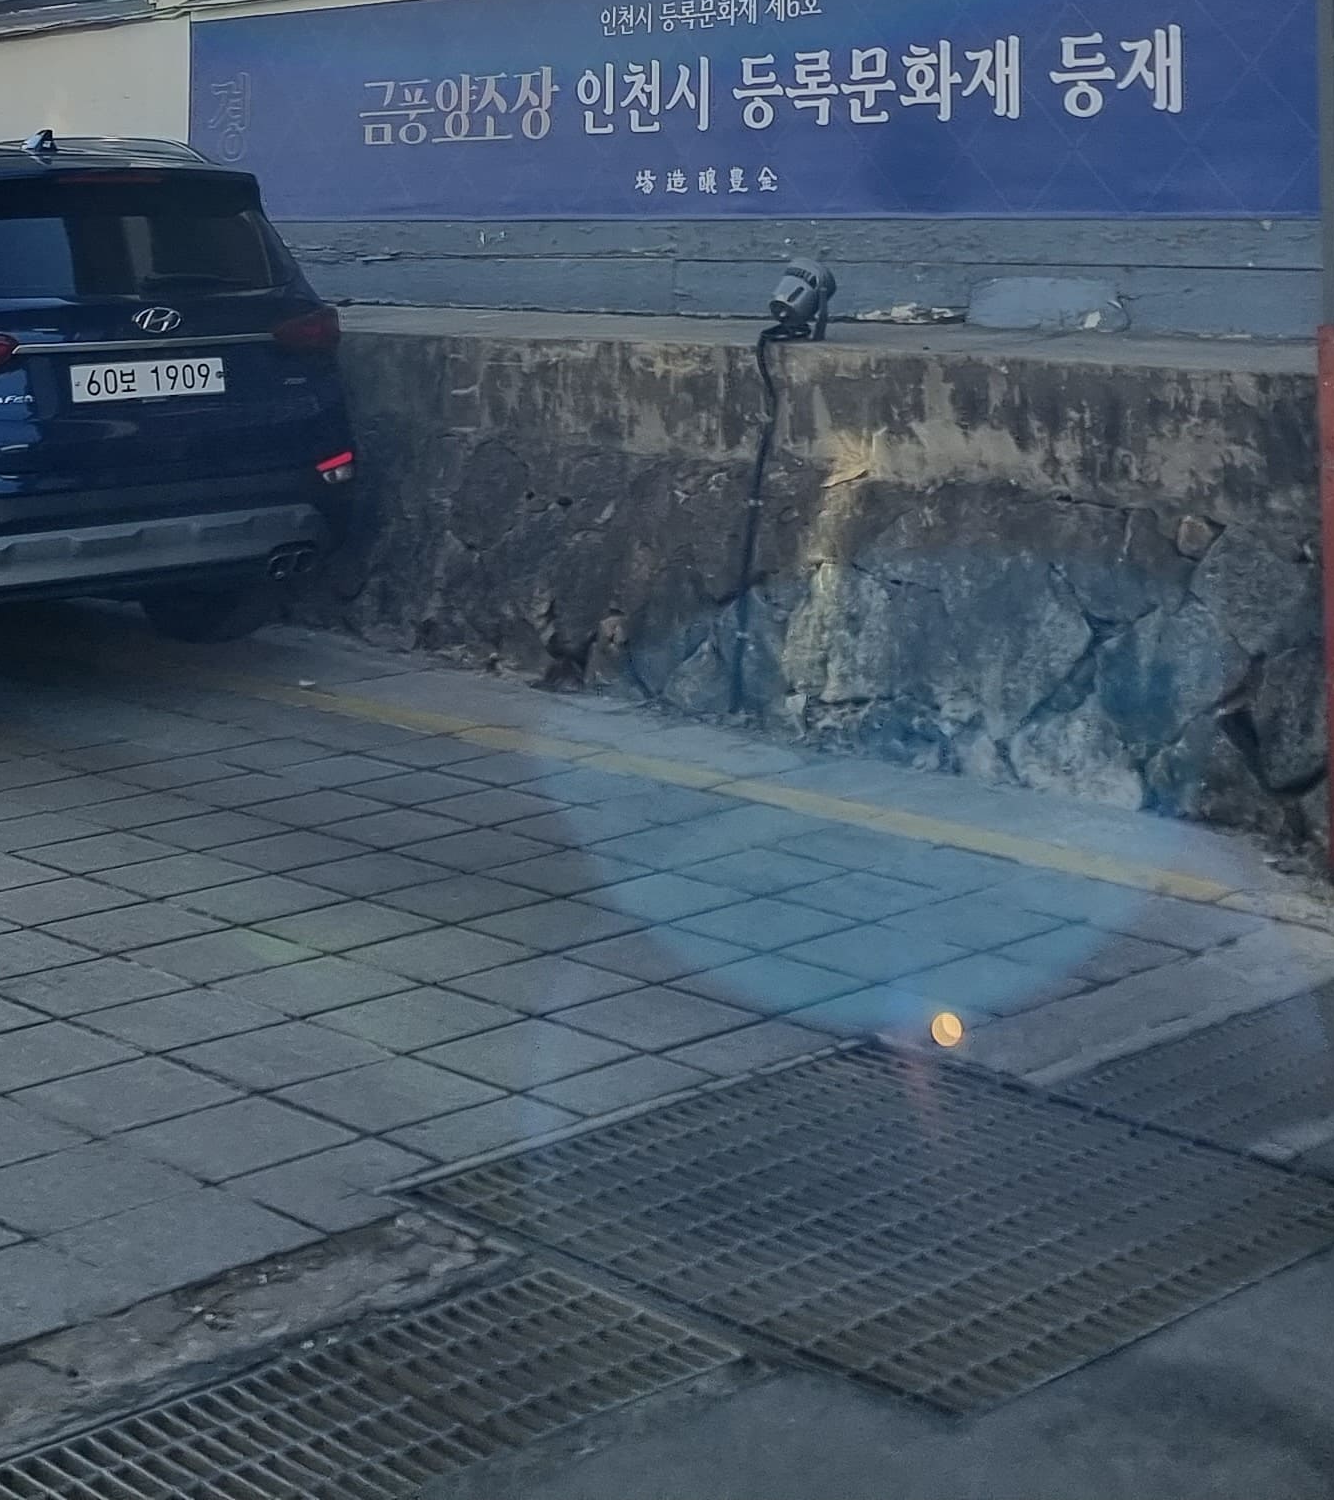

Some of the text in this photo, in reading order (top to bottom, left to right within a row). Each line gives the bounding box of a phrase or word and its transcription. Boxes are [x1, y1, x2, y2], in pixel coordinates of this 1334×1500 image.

[600, 2, 652, 37] 인천시
[358, 23, 1183, 146] 금풍양조장 인천시 등록문화재 등재
[85, 363, 211, 397] 60보 1909
